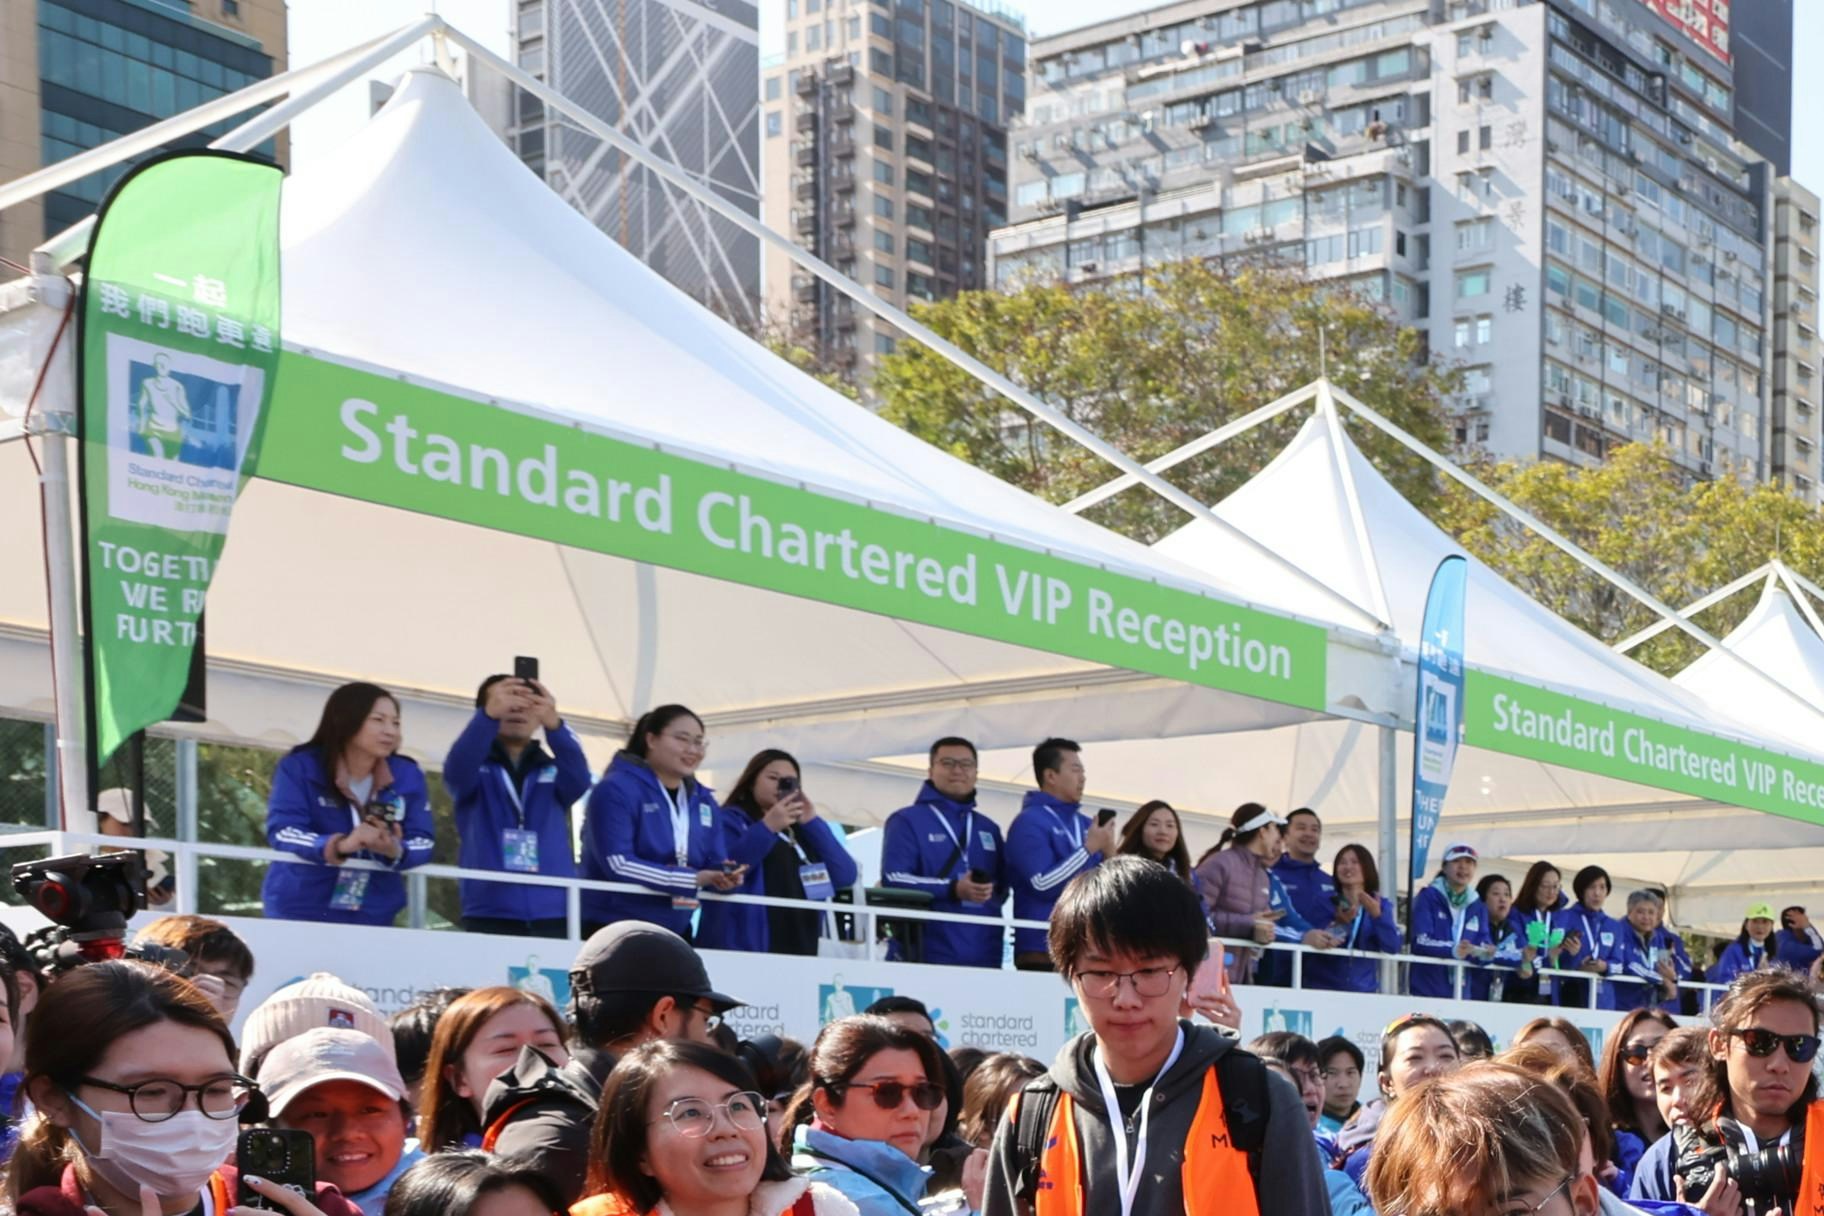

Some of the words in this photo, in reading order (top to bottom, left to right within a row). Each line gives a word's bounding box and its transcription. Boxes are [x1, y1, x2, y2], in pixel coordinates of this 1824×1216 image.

[340, 398, 672, 534] Standard
[696, 491, 977, 606] Chartered
[996, 562, 1071, 624] VIP
[1087, 589, 1291, 679] Reception
[120, 580, 168, 612] WE
[116, 613, 196, 647] FURT
[1492, 693, 1615, 757] Standard
[1623, 727, 1737, 787] Chartered
[1742, 758, 1776, 795] VIP
[960, 1014, 1033, 1030] standard
[961, 1031, 1037, 1048] chartered
